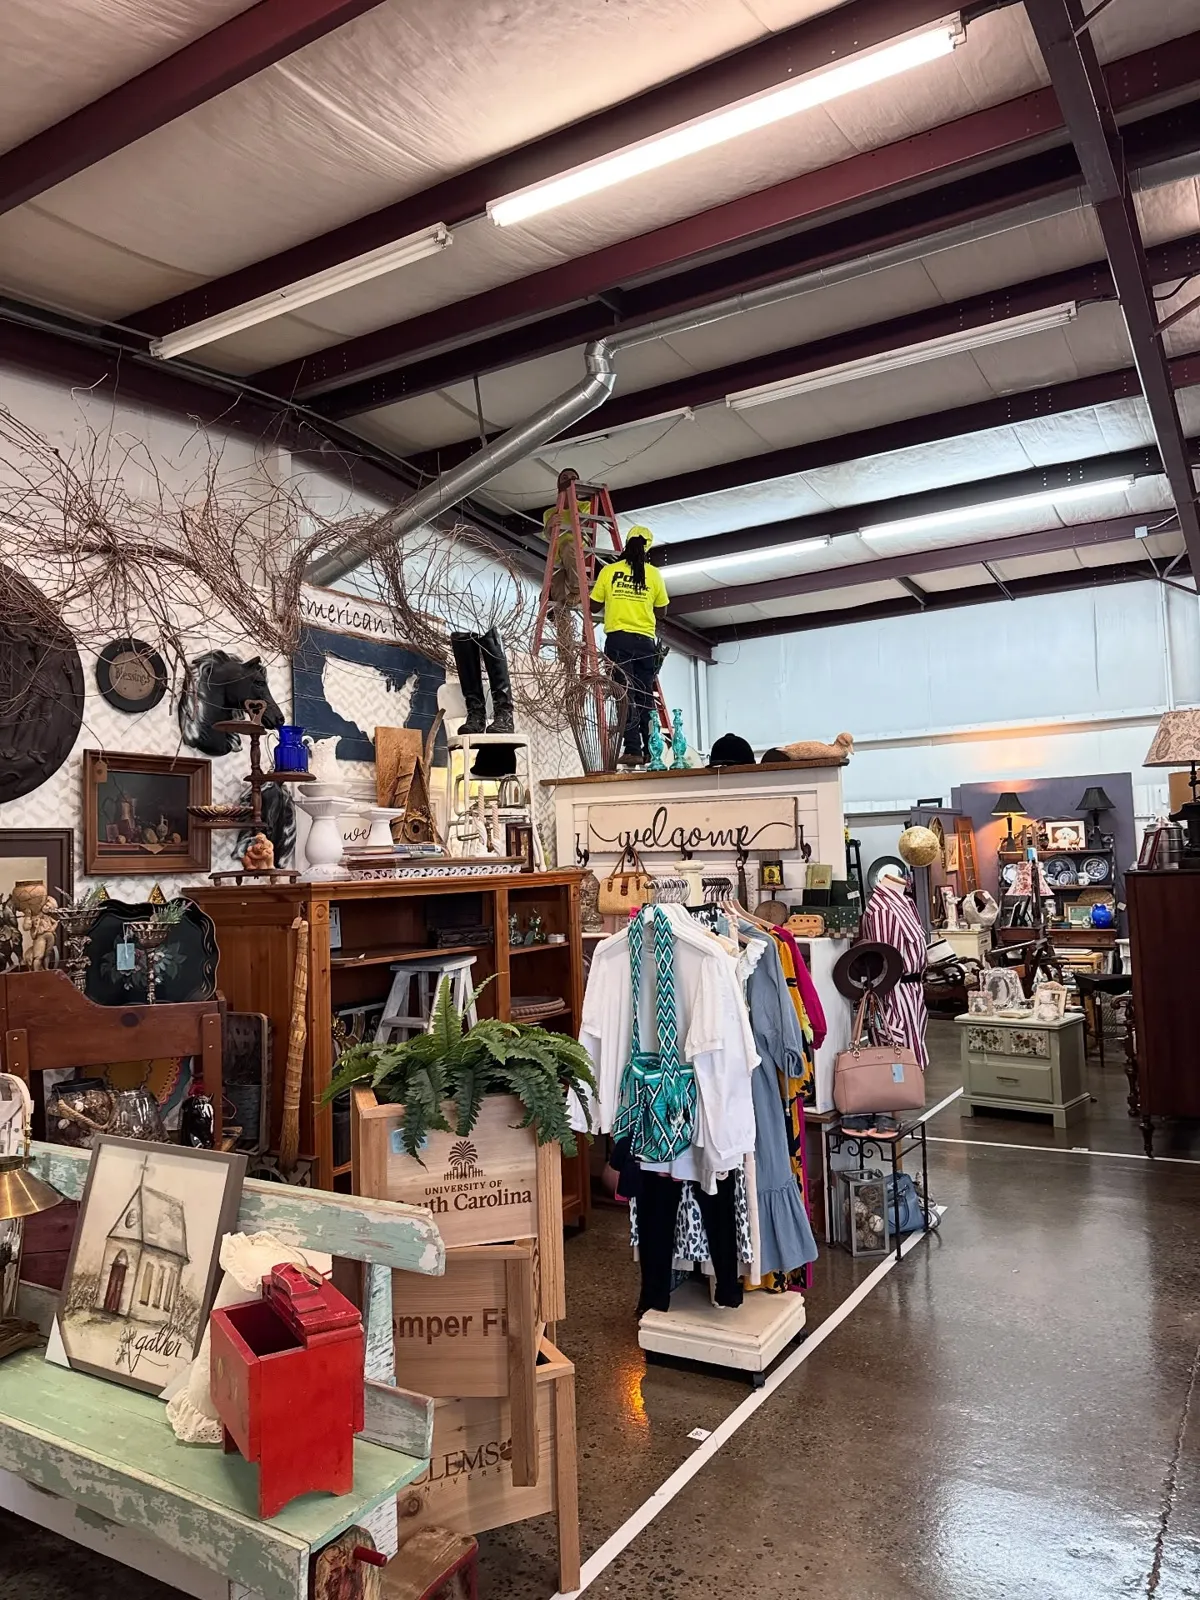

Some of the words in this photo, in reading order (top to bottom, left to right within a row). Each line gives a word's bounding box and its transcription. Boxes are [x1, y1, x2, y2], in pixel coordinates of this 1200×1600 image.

[616, 581, 651, 592] Elecic
[115, 666, 151, 686] Blessings
[589, 806, 793, 848] welcome
[425, 1181, 486, 1196] UNIVERSITY
[489, 1179, 503, 1189] OF
[453, 1188, 533, 1211] Carolina
[392, 1314, 473, 1345] mper
[482, 1308, 507, 1337] Fi
[129, 1322, 182, 1374] gather
